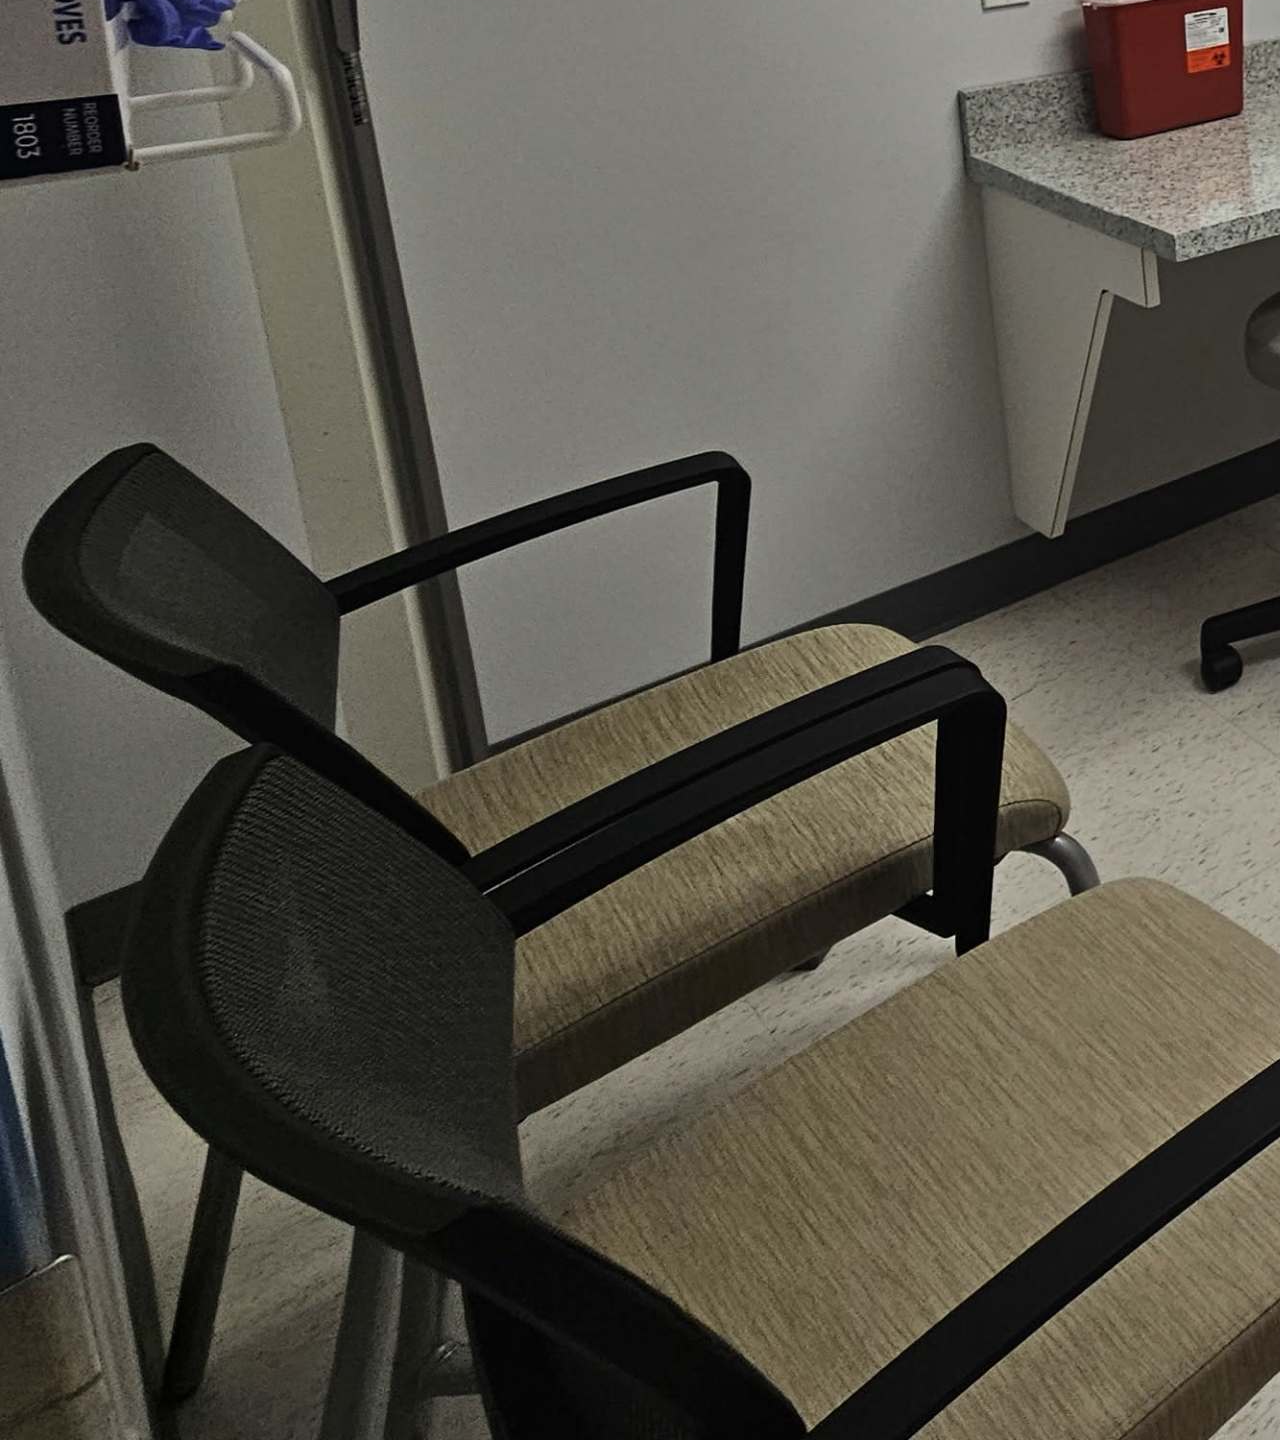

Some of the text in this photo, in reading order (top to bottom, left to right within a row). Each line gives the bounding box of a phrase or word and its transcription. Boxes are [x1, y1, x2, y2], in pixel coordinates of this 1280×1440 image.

[11, 113, 41, 160] 1803
[62, 108, 83, 156] NUMBER
[83, 102, 103, 154] REORDER
